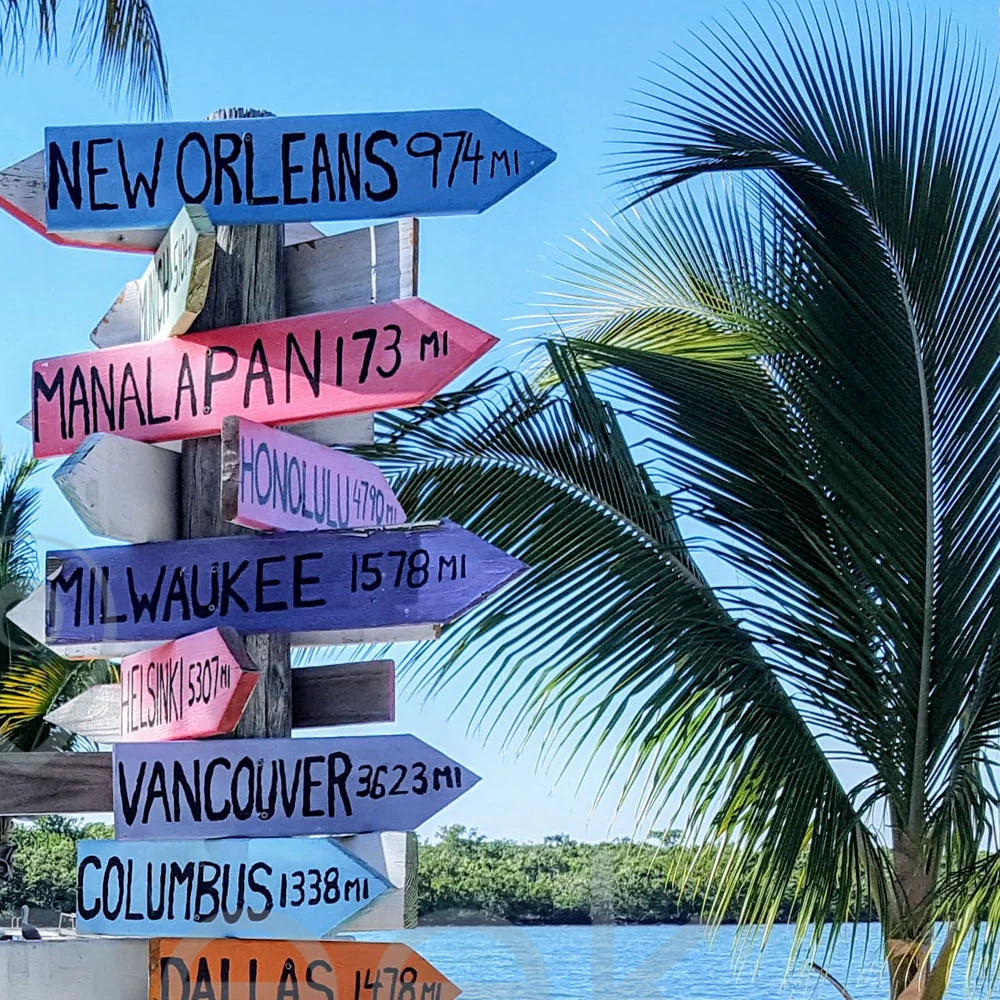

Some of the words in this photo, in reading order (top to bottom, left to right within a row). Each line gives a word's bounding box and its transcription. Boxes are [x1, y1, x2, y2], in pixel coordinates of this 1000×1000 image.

[46, 136, 164, 211] NEW
[175, 128, 400, 206] ORLEANS
[405, 128, 485, 190] 974
[488, 148, 522, 179] MI
[32, 328, 322, 444] MANALAPAN
[335, 324, 401, 386] 173
[418, 330, 449, 362] MI
[240, 436, 350, 529] HONOLULU
[351, 477, 385, 526] 4790
[385, 502, 398, 524] MI
[48, 552, 327, 628] MILWAUKEE
[349, 548, 430, 593] 1578
[437, 552, 468, 583] MI
[120, 656, 184, 737] HELSINKI
[187, 655, 220, 708] 5307
[219, 663, 232, 689] MI
[116, 750, 354, 826] VANCOUVER
[355, 763, 430, 800] 3623
[431, 765, 463, 791] MI
[77, 854, 275, 924] COLUMBUS
[278, 868, 342, 910] 1338
[342, 875, 370, 902] MI
